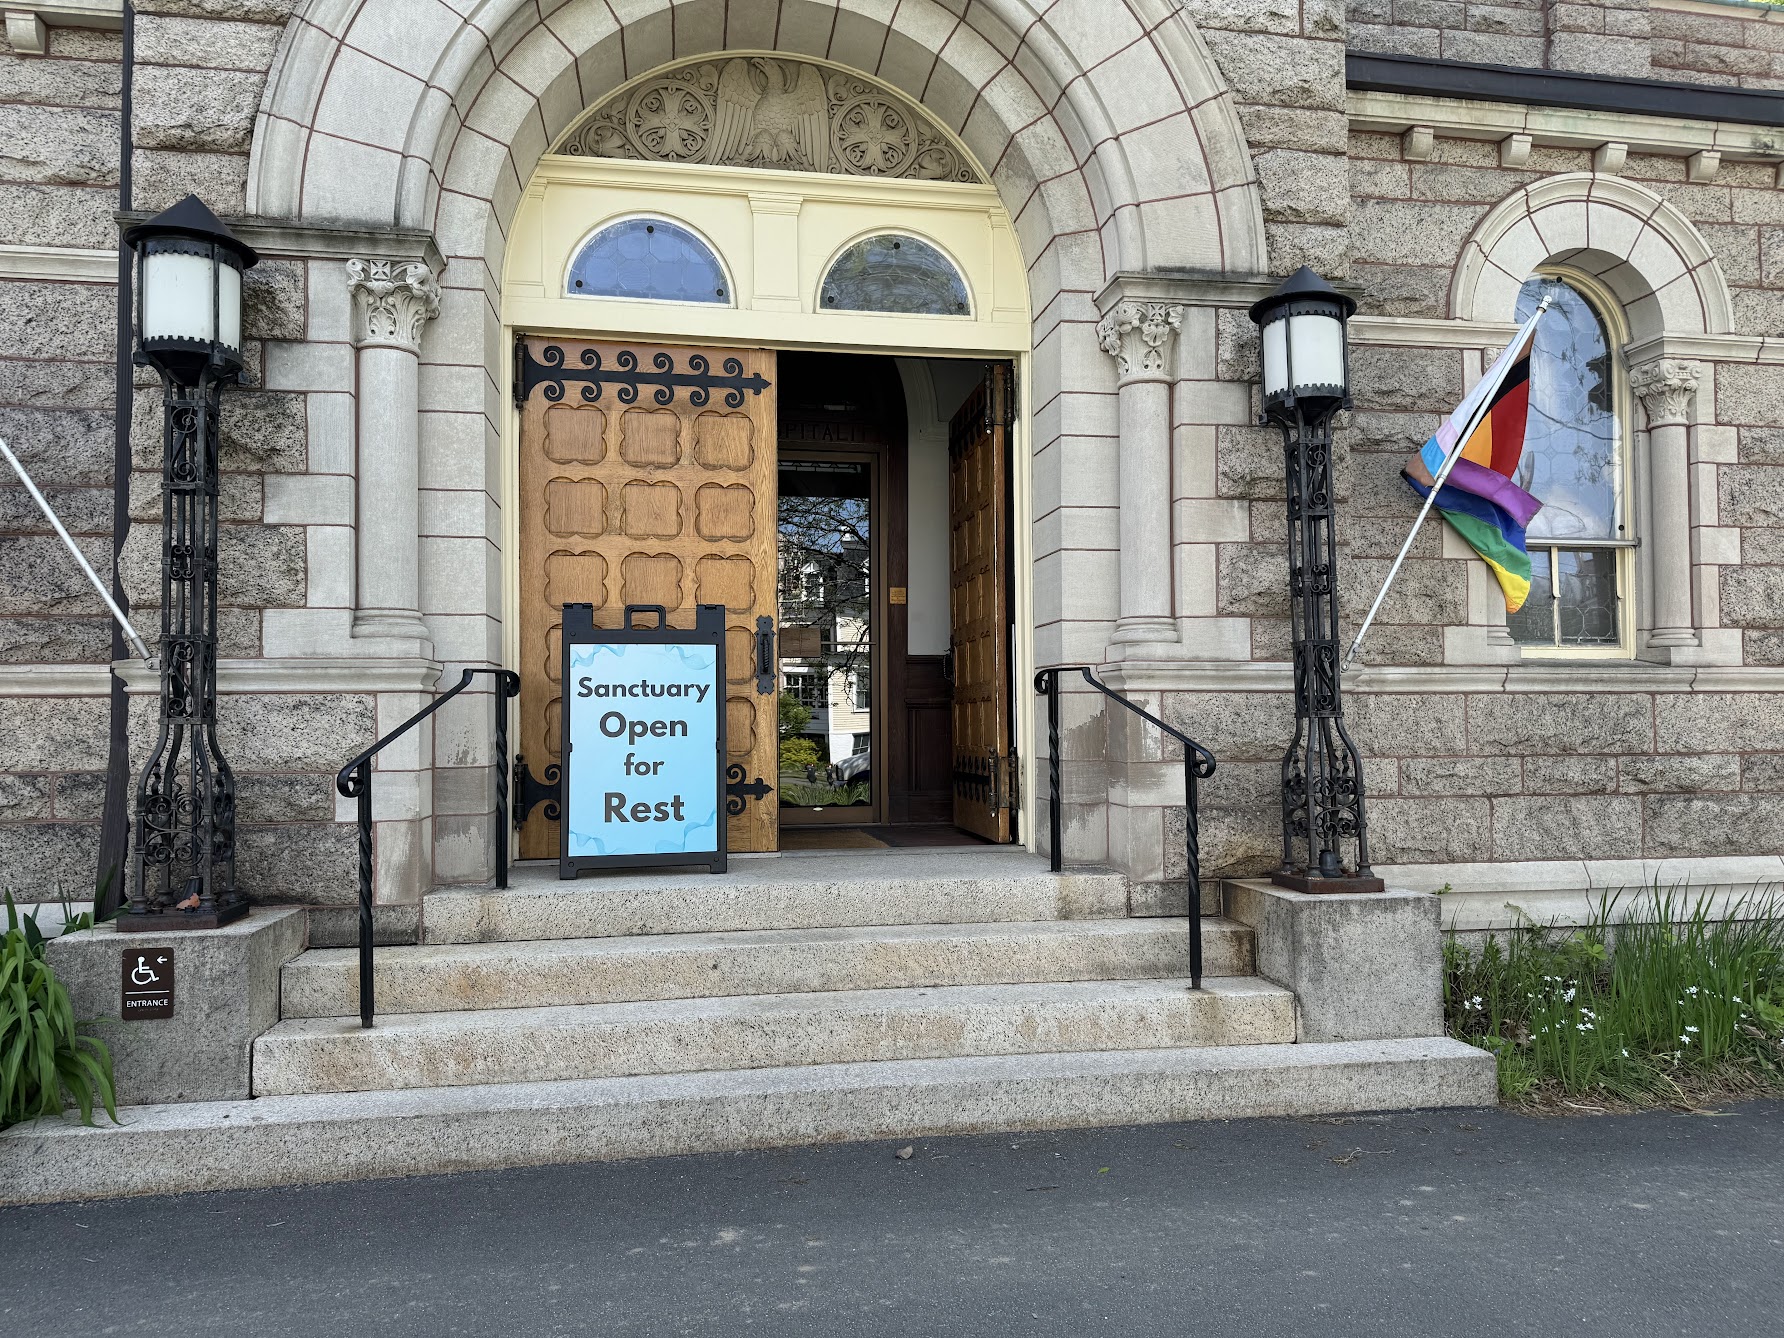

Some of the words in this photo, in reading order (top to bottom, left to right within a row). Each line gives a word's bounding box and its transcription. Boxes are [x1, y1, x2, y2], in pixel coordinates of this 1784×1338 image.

[577, 676, 711, 703] Sanctuary
[599, 710, 688, 745] Open
[624, 753, 665, 776] for
[604, 792, 685, 823] Rest
[126, 999, 168, 1008] ENTRANCE
